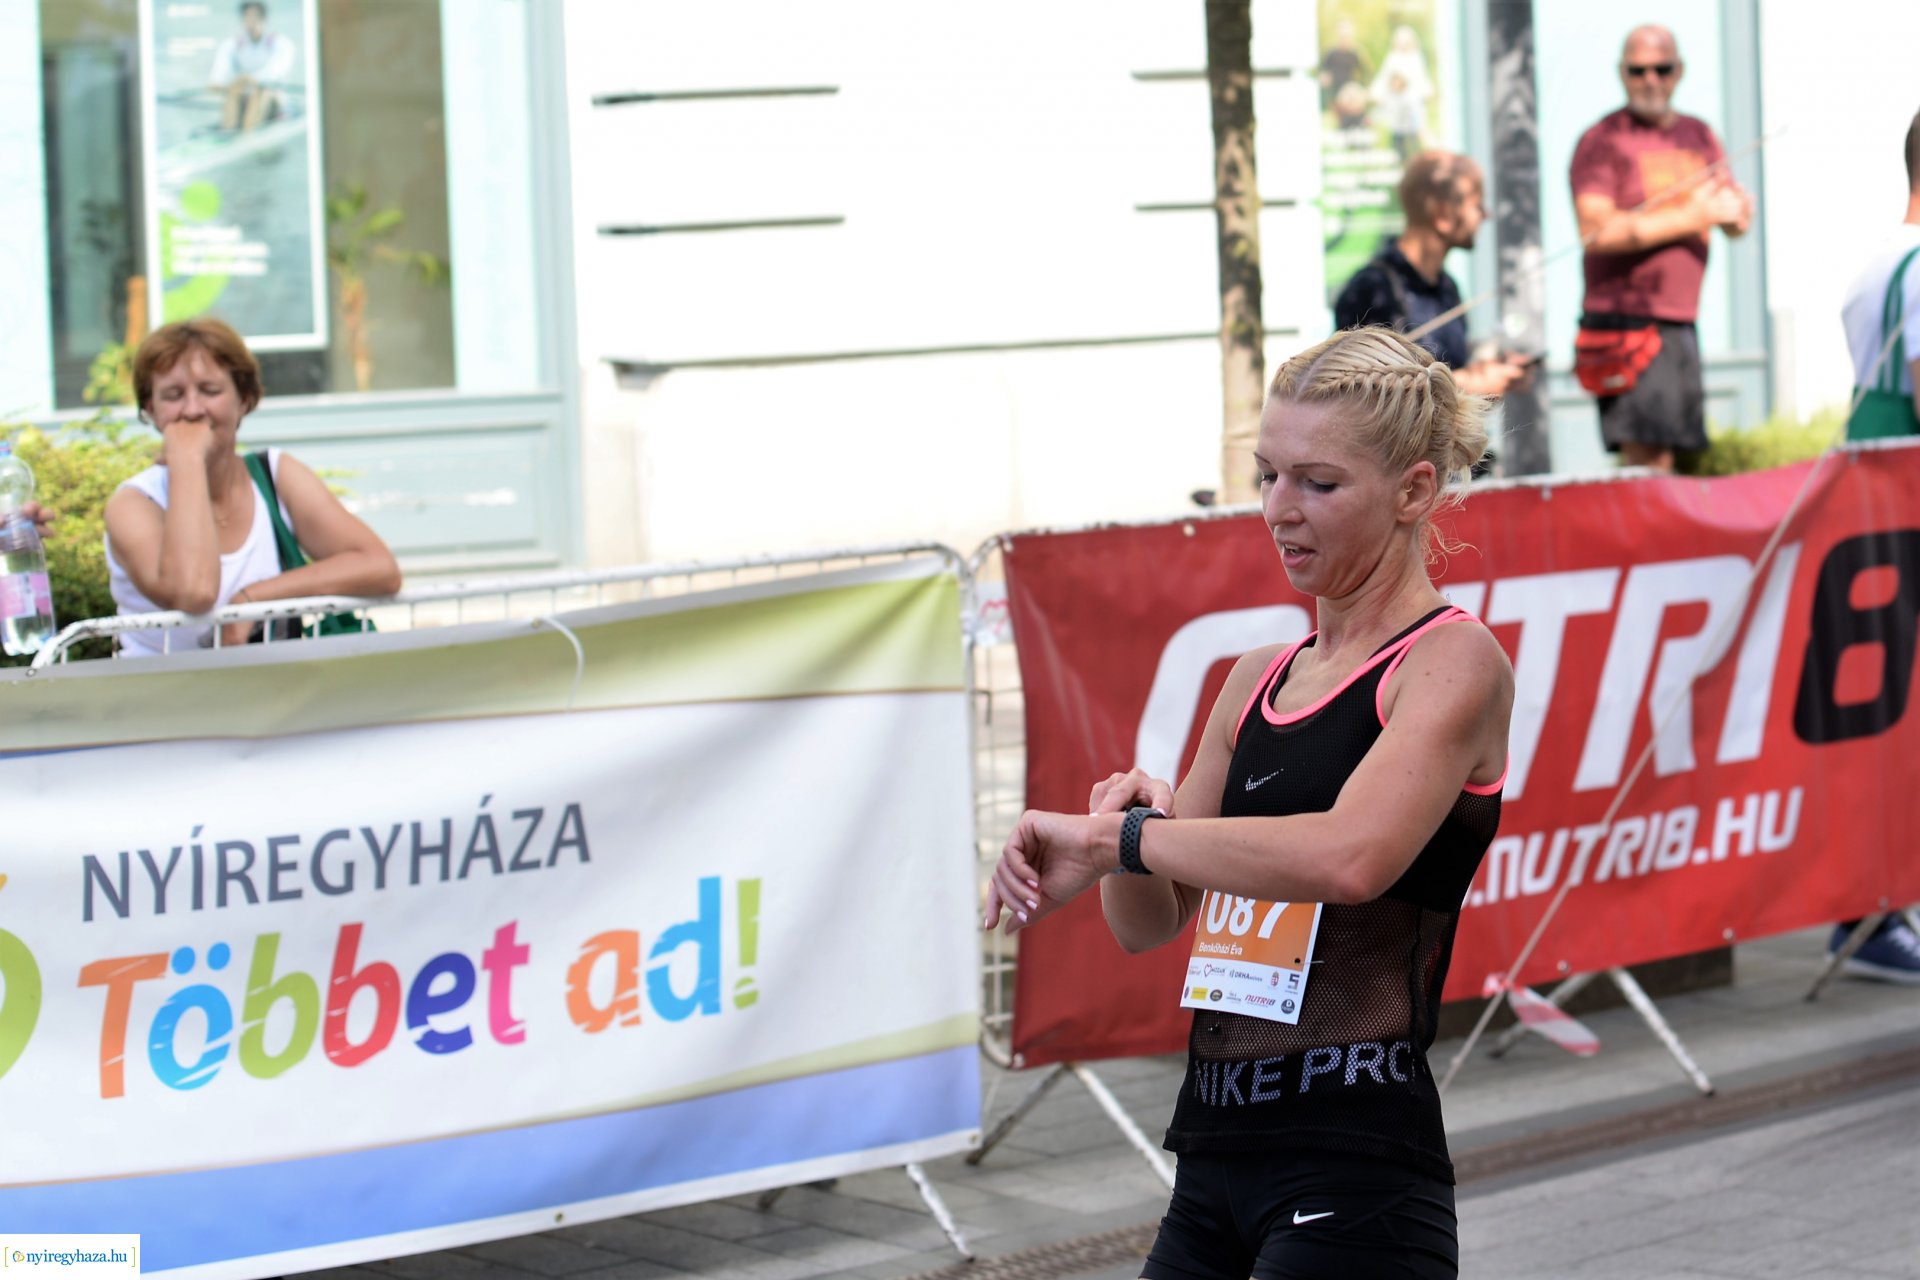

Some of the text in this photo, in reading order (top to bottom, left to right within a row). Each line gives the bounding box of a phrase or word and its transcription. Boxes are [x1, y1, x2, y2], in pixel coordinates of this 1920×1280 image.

[82, 794, 592, 923] NYÍREGYHÁZA
[1461, 786, 1804, 911] .NUTRI8.HU
[77, 875, 762, 1100] Többet ad!
[1230, 941, 1243, 956] Éva
[1194, 1054, 1286, 1107] NIKE
